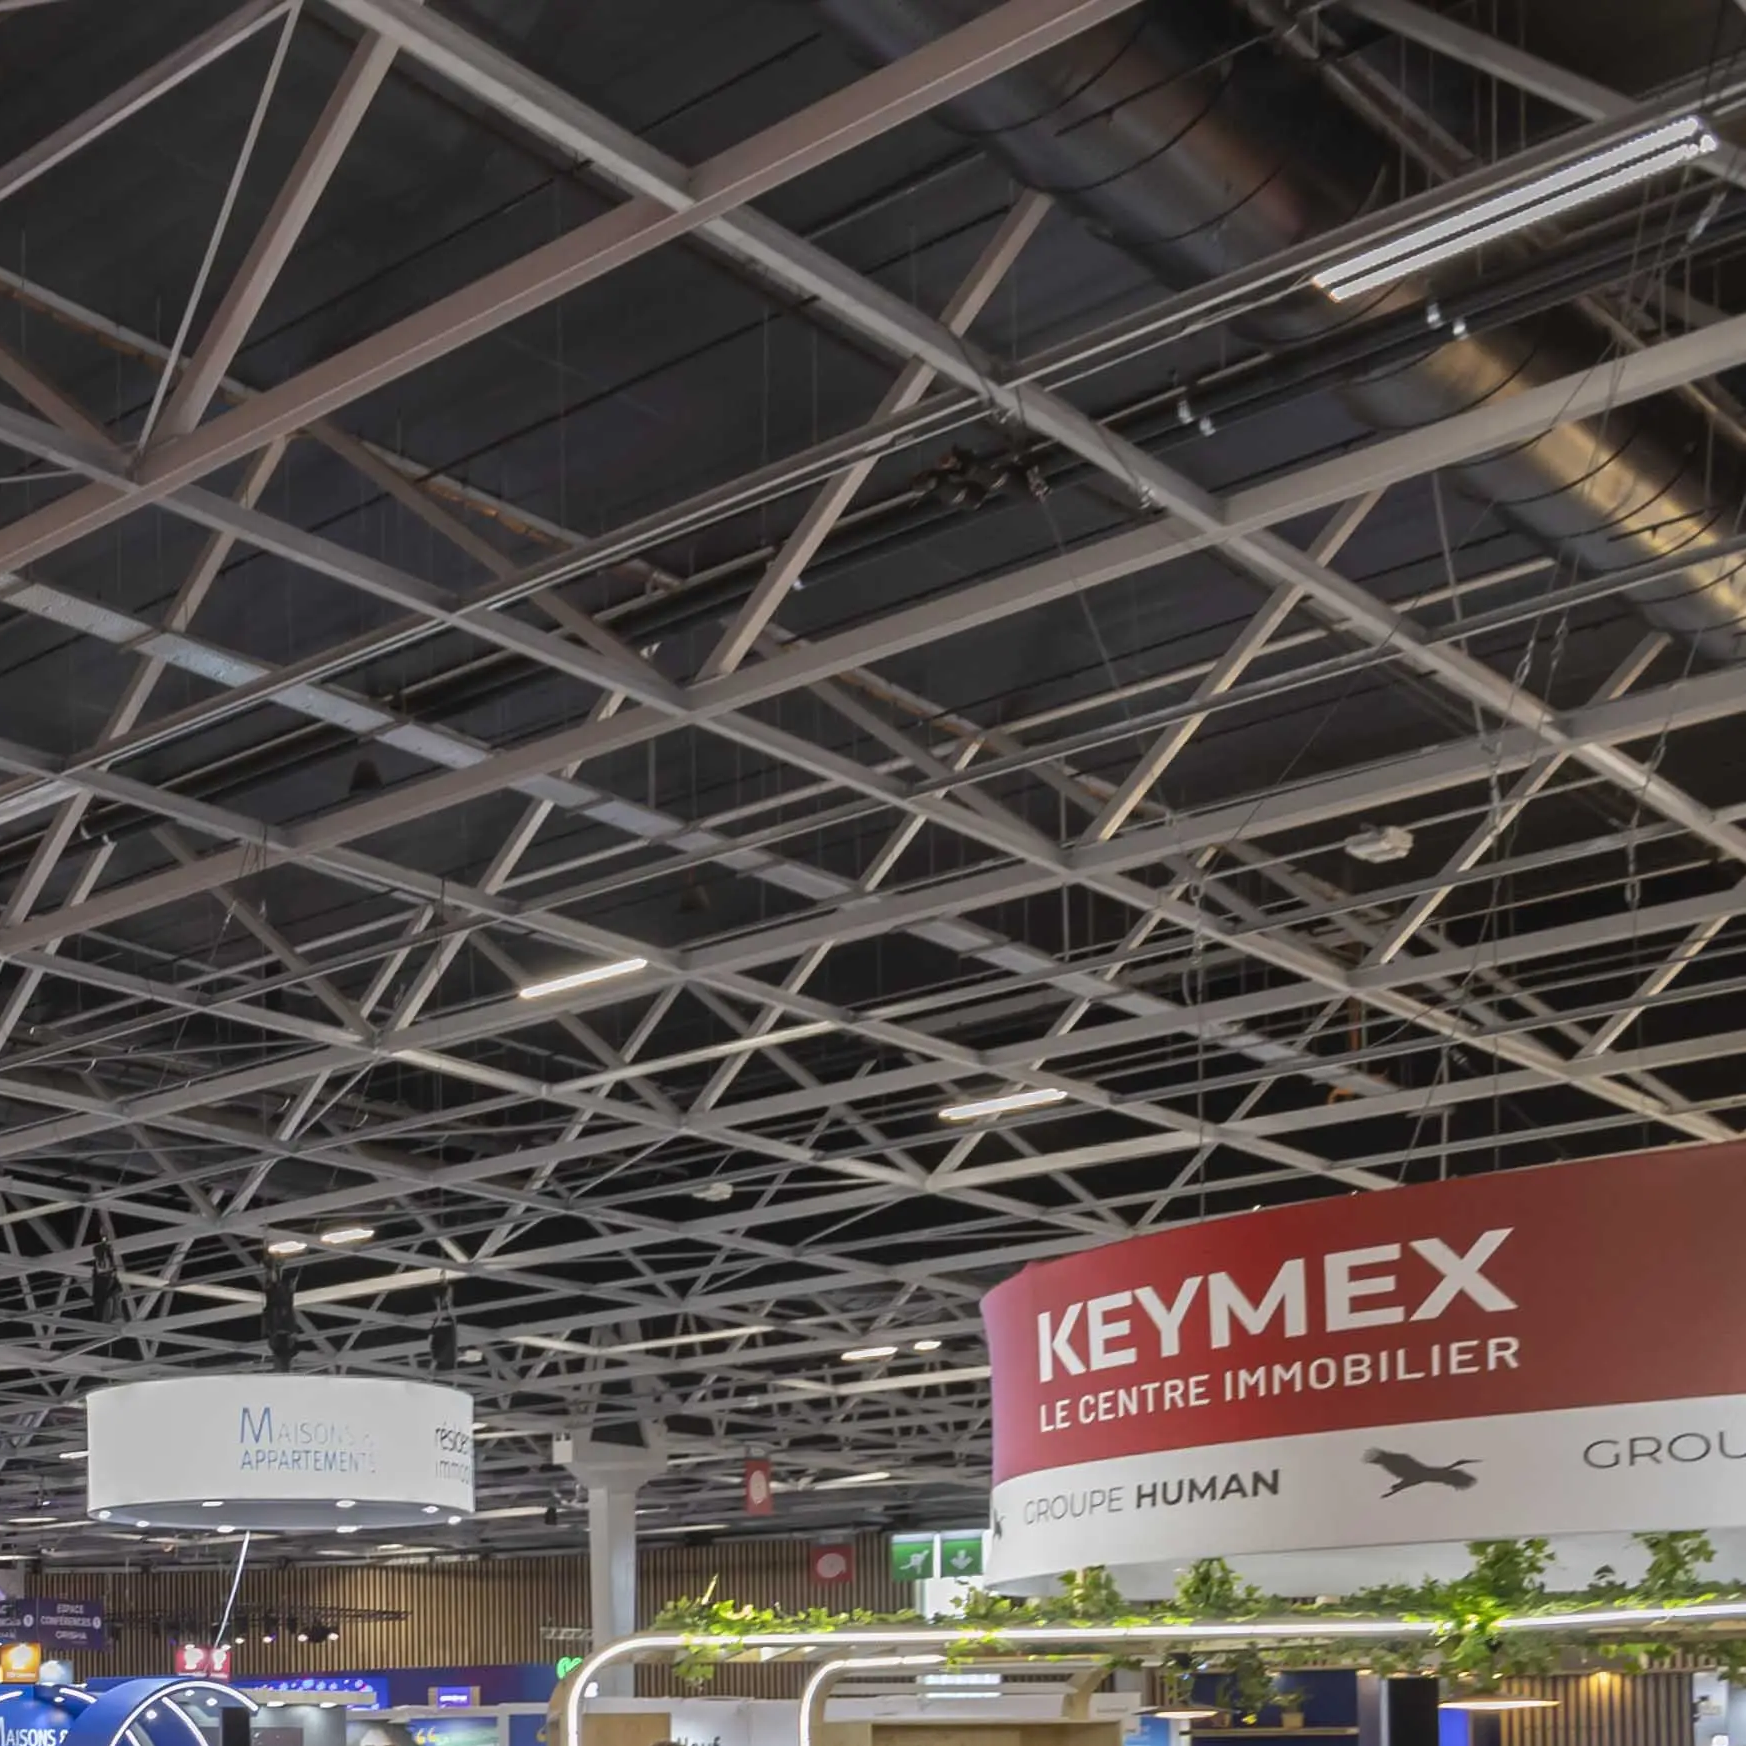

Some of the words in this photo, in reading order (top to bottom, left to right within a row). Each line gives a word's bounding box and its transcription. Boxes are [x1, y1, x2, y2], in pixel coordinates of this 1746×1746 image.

[1038, 1227, 1518, 1383] KEYMEX
[1040, 1399, 1071, 1433] LE
[1078, 1374, 1211, 1426] CENTRE
[1224, 1336, 1521, 1402] IMMOBILIER
[1023, 1486, 1124, 1528] GROUPE
[1135, 1468, 1281, 1510] HUMAN
